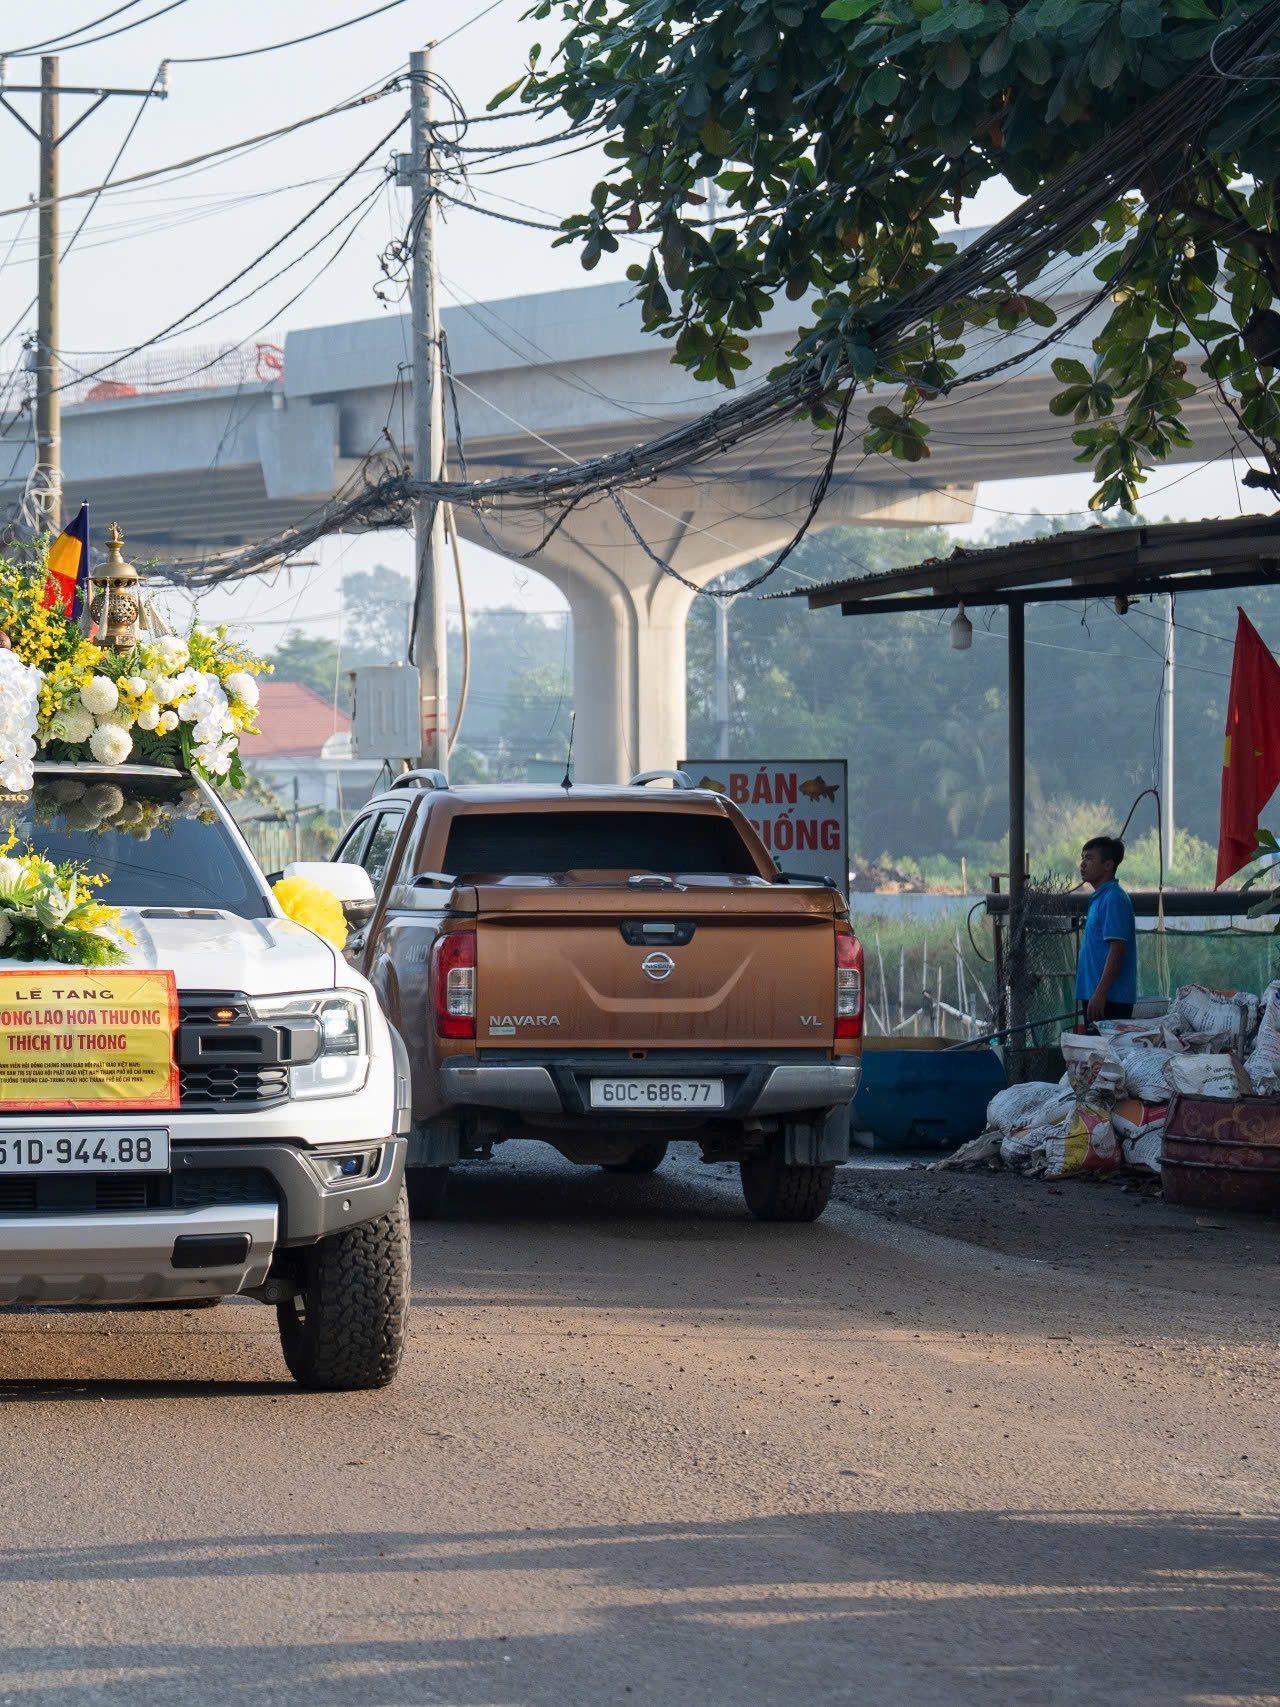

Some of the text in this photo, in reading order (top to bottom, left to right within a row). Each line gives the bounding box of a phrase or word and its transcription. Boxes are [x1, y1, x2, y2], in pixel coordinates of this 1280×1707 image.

[729, 766, 798, 804] BÁN
[52, 989, 114, 1000] TANG
[489, 1015, 561, 1027] NAVARA
[800, 1015, 822, 1026] VL
[603, 1084, 711, 1103] 60C-686.77
